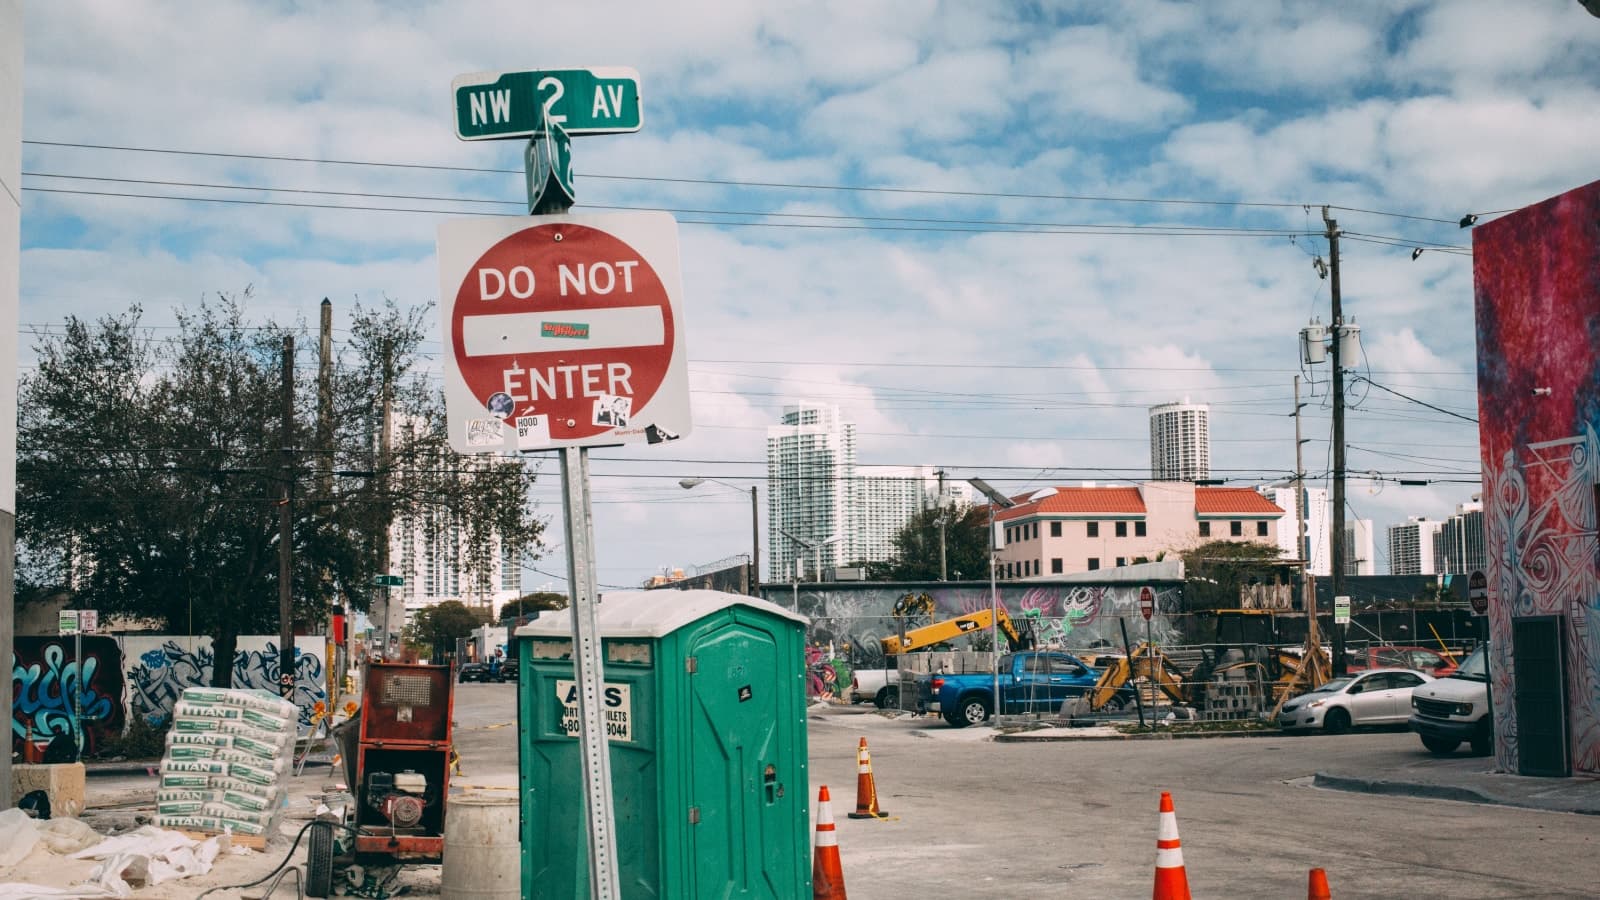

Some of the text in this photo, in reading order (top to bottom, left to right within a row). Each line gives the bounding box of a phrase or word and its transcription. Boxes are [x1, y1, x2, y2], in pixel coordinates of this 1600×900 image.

[469, 77, 623, 126] NW 2 AV
[478, 260, 639, 301] DO NOT
[503, 362, 634, 402] ENTER
[517, 417, 538, 427] HOOD
[519, 428, 529, 437] BY
[182, 706, 226, 719] TITAN
[173, 735, 216, 745] TITAN
[166, 761, 210, 772] TITAN
[158, 791, 201, 801] TITAN
[160, 816, 204, 828] TITAN
